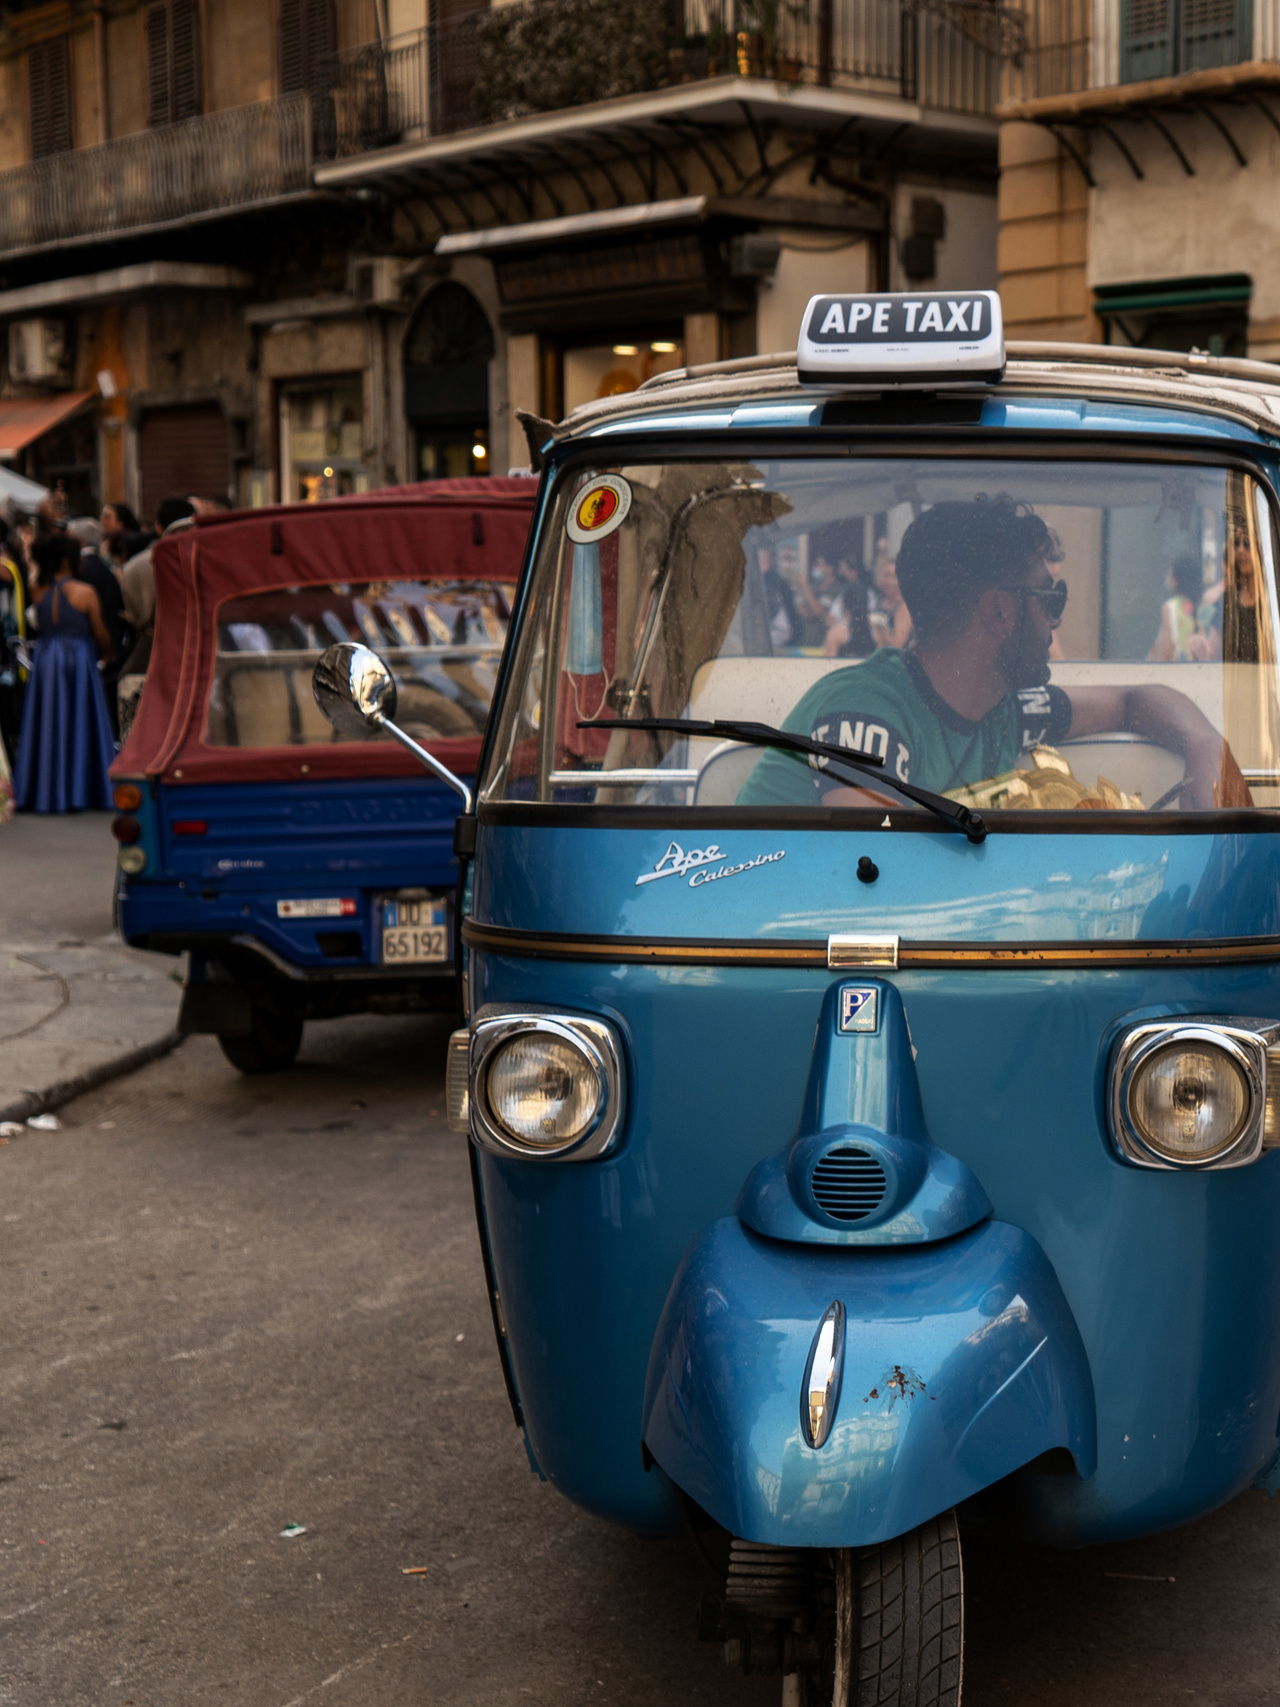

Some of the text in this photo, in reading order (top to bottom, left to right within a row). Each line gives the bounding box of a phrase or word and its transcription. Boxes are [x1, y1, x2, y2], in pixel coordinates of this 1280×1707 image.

[819, 301, 983, 334] APE TAXI
[650, 841, 728, 879] Ape
[688, 850, 786, 888] Calessino
[386, 931, 443, 958] 65192
[845, 992, 864, 1017] P
